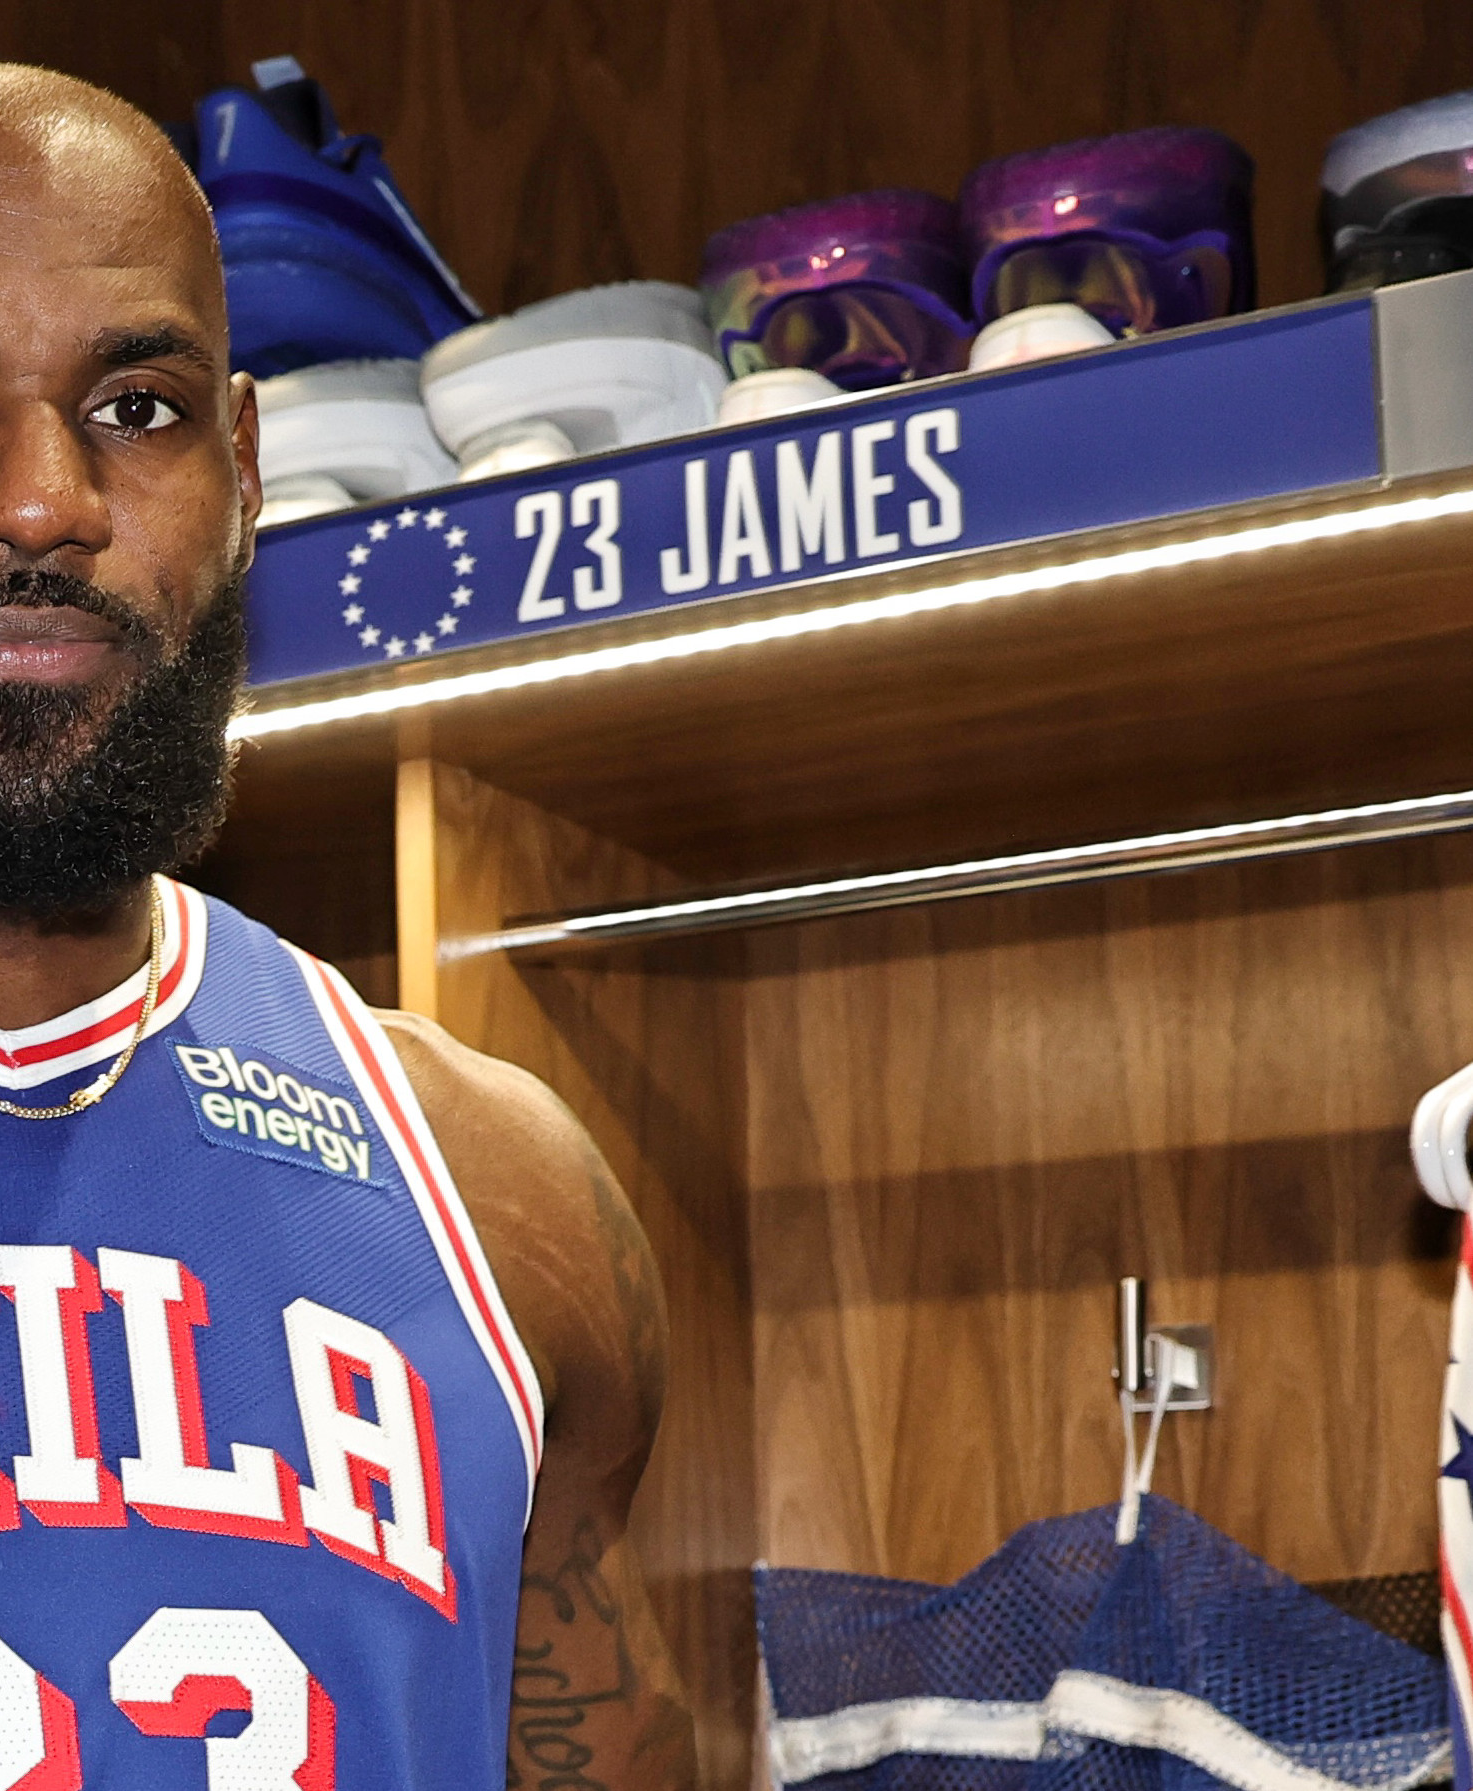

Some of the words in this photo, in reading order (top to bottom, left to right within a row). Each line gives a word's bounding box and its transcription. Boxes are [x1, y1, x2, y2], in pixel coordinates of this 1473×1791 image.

[516, 479, 623, 623] 23
[659, 408, 963, 595] JAMES
[176, 1045, 363, 1135] Bloom
[202, 1092, 369, 1179] energy
